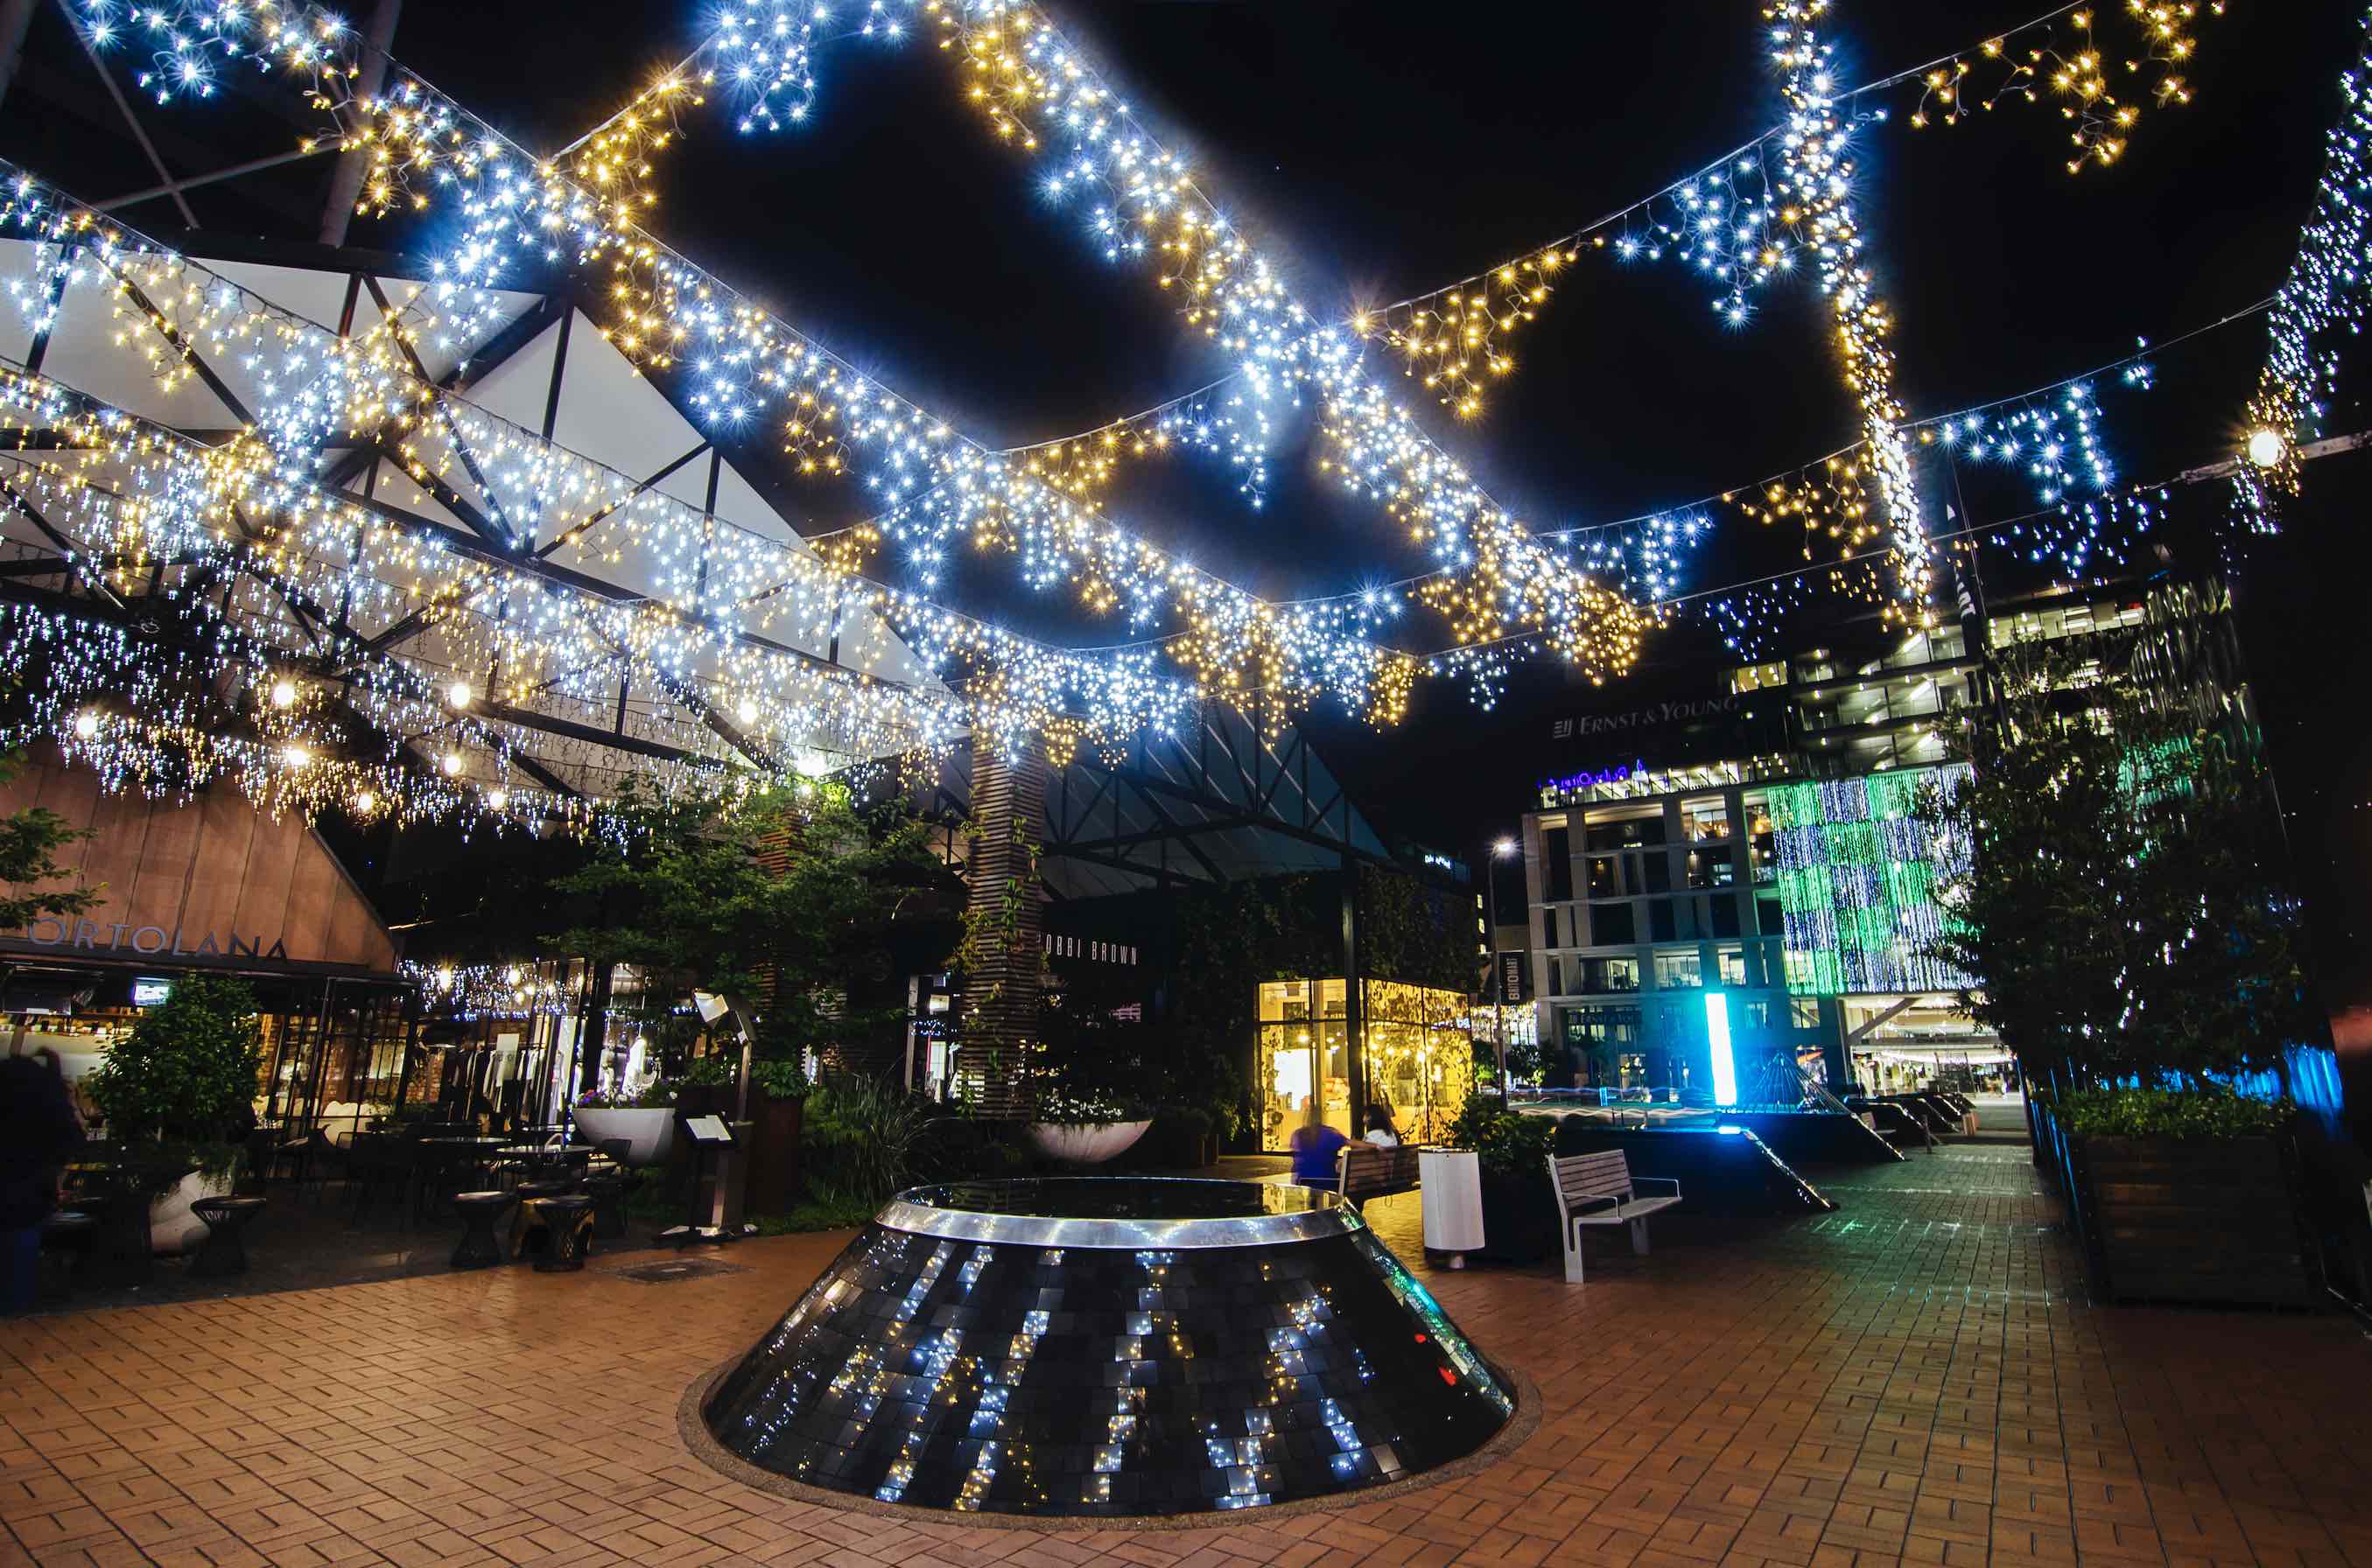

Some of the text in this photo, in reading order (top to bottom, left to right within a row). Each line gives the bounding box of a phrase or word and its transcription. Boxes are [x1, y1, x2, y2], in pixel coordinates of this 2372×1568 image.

[1579, 696, 1739, 735] ERNST & YOUNG
[28, 916, 287, 960] ORTOLANA
[1091, 941, 1138, 966] BROWN
